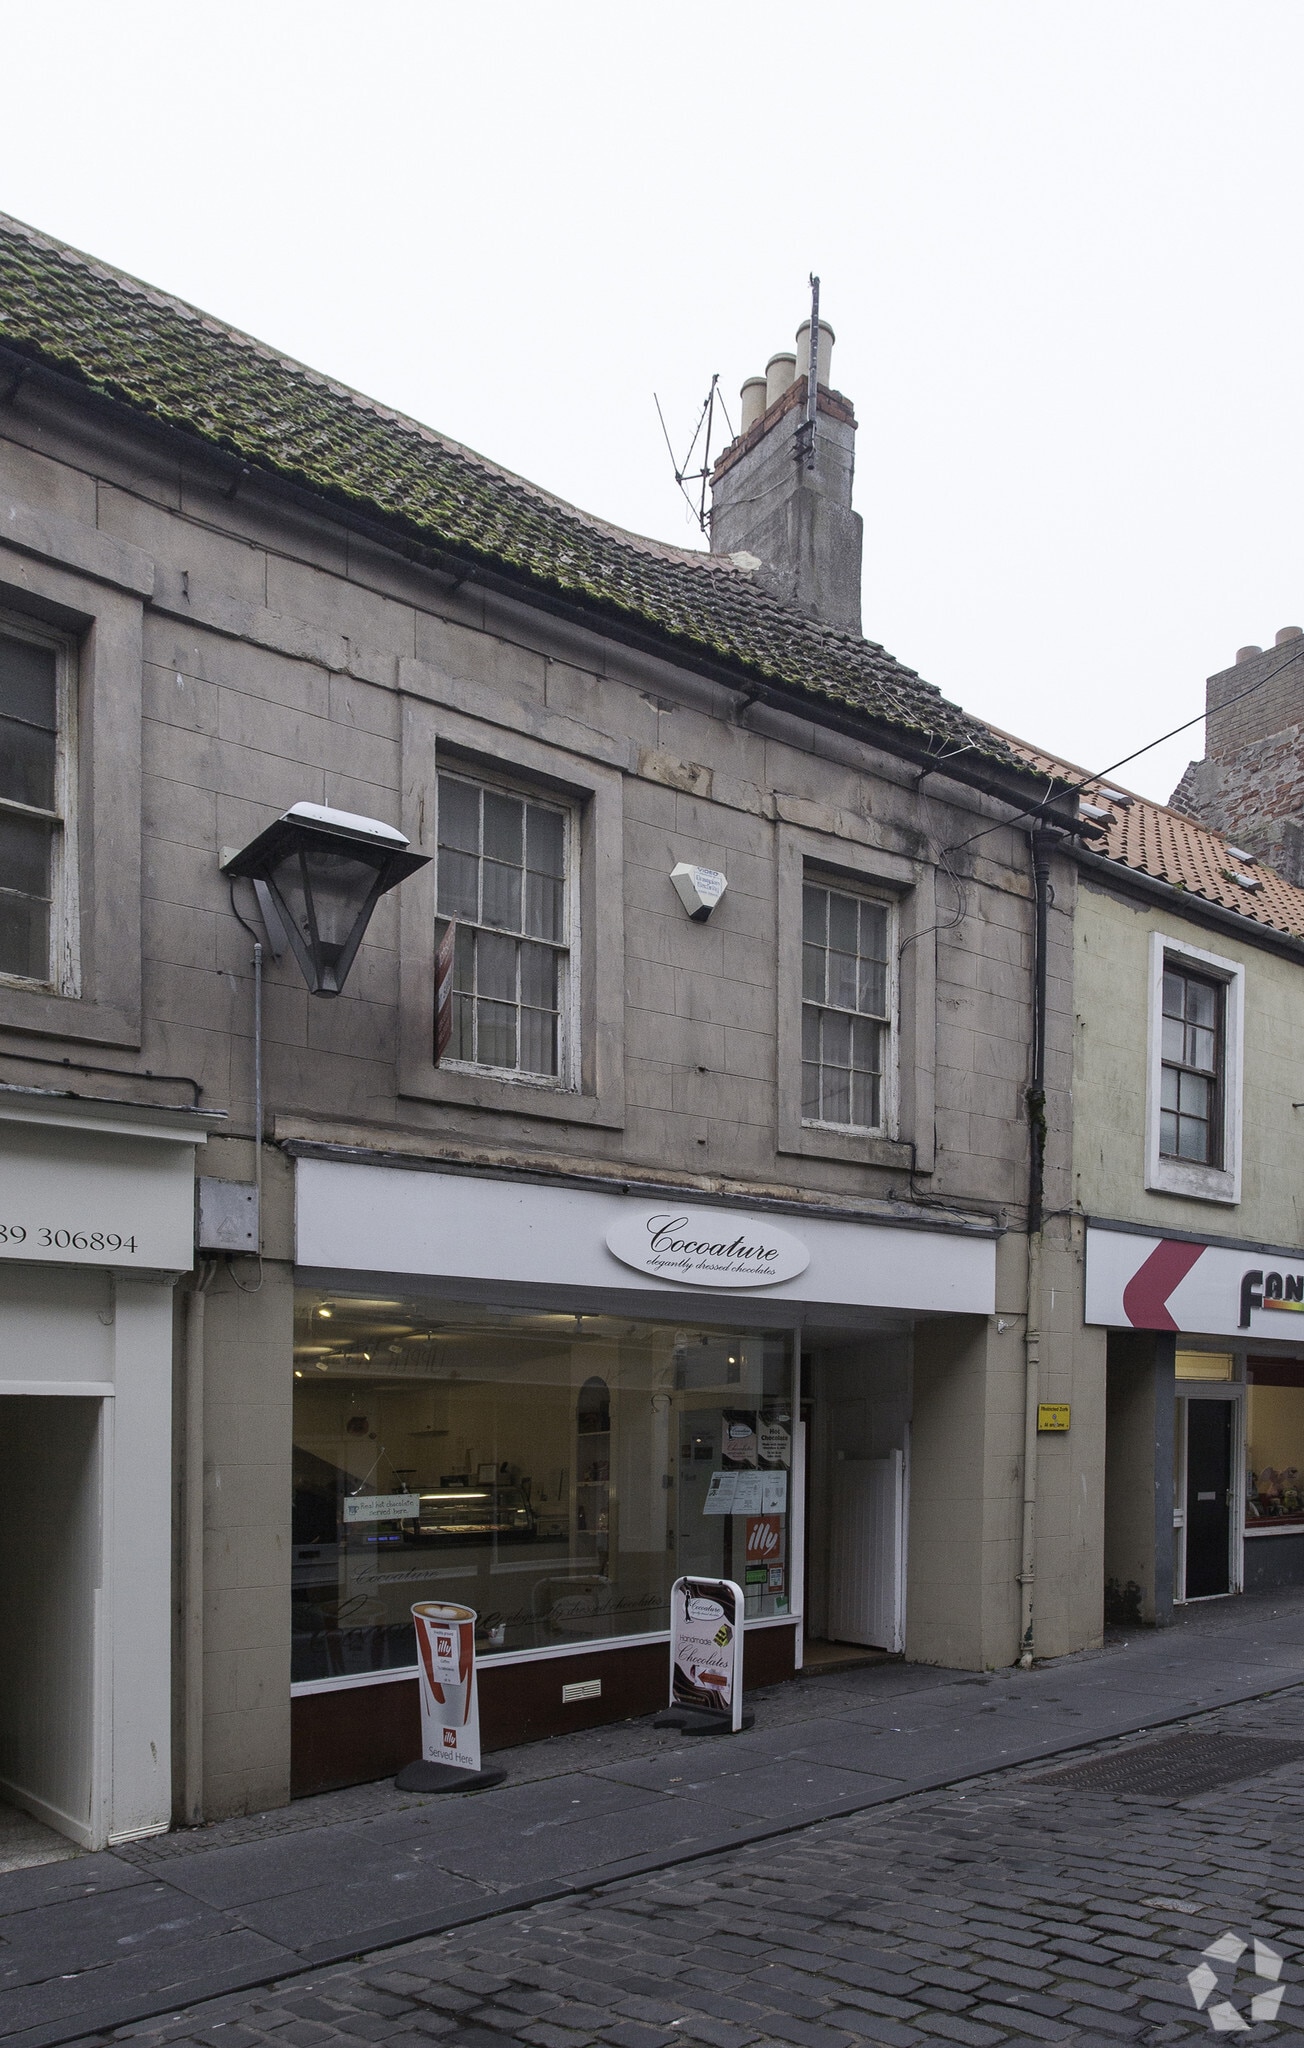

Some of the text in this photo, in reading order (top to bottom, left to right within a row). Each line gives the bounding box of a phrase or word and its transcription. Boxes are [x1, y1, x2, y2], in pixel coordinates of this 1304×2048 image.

[37, 1227, 139, 1254] 306894
[646, 1214, 779, 1262] Cocoature
[646, 1254, 776, 1276] elegantly dressed chocolates
[360, 1501, 375, 1510] Real
[386, 1499, 415, 1508] chocolate
[369, 1508, 391, 1516] served
[748, 1523, 778, 1556] illy
[437, 1638, 452, 1656] illy
[679, 1634, 713, 1646] Handmade
[678, 1642, 729, 1668] Chocolates
[443, 1730, 457, 1747] illy
[428, 1746, 474, 1766] Served Here
